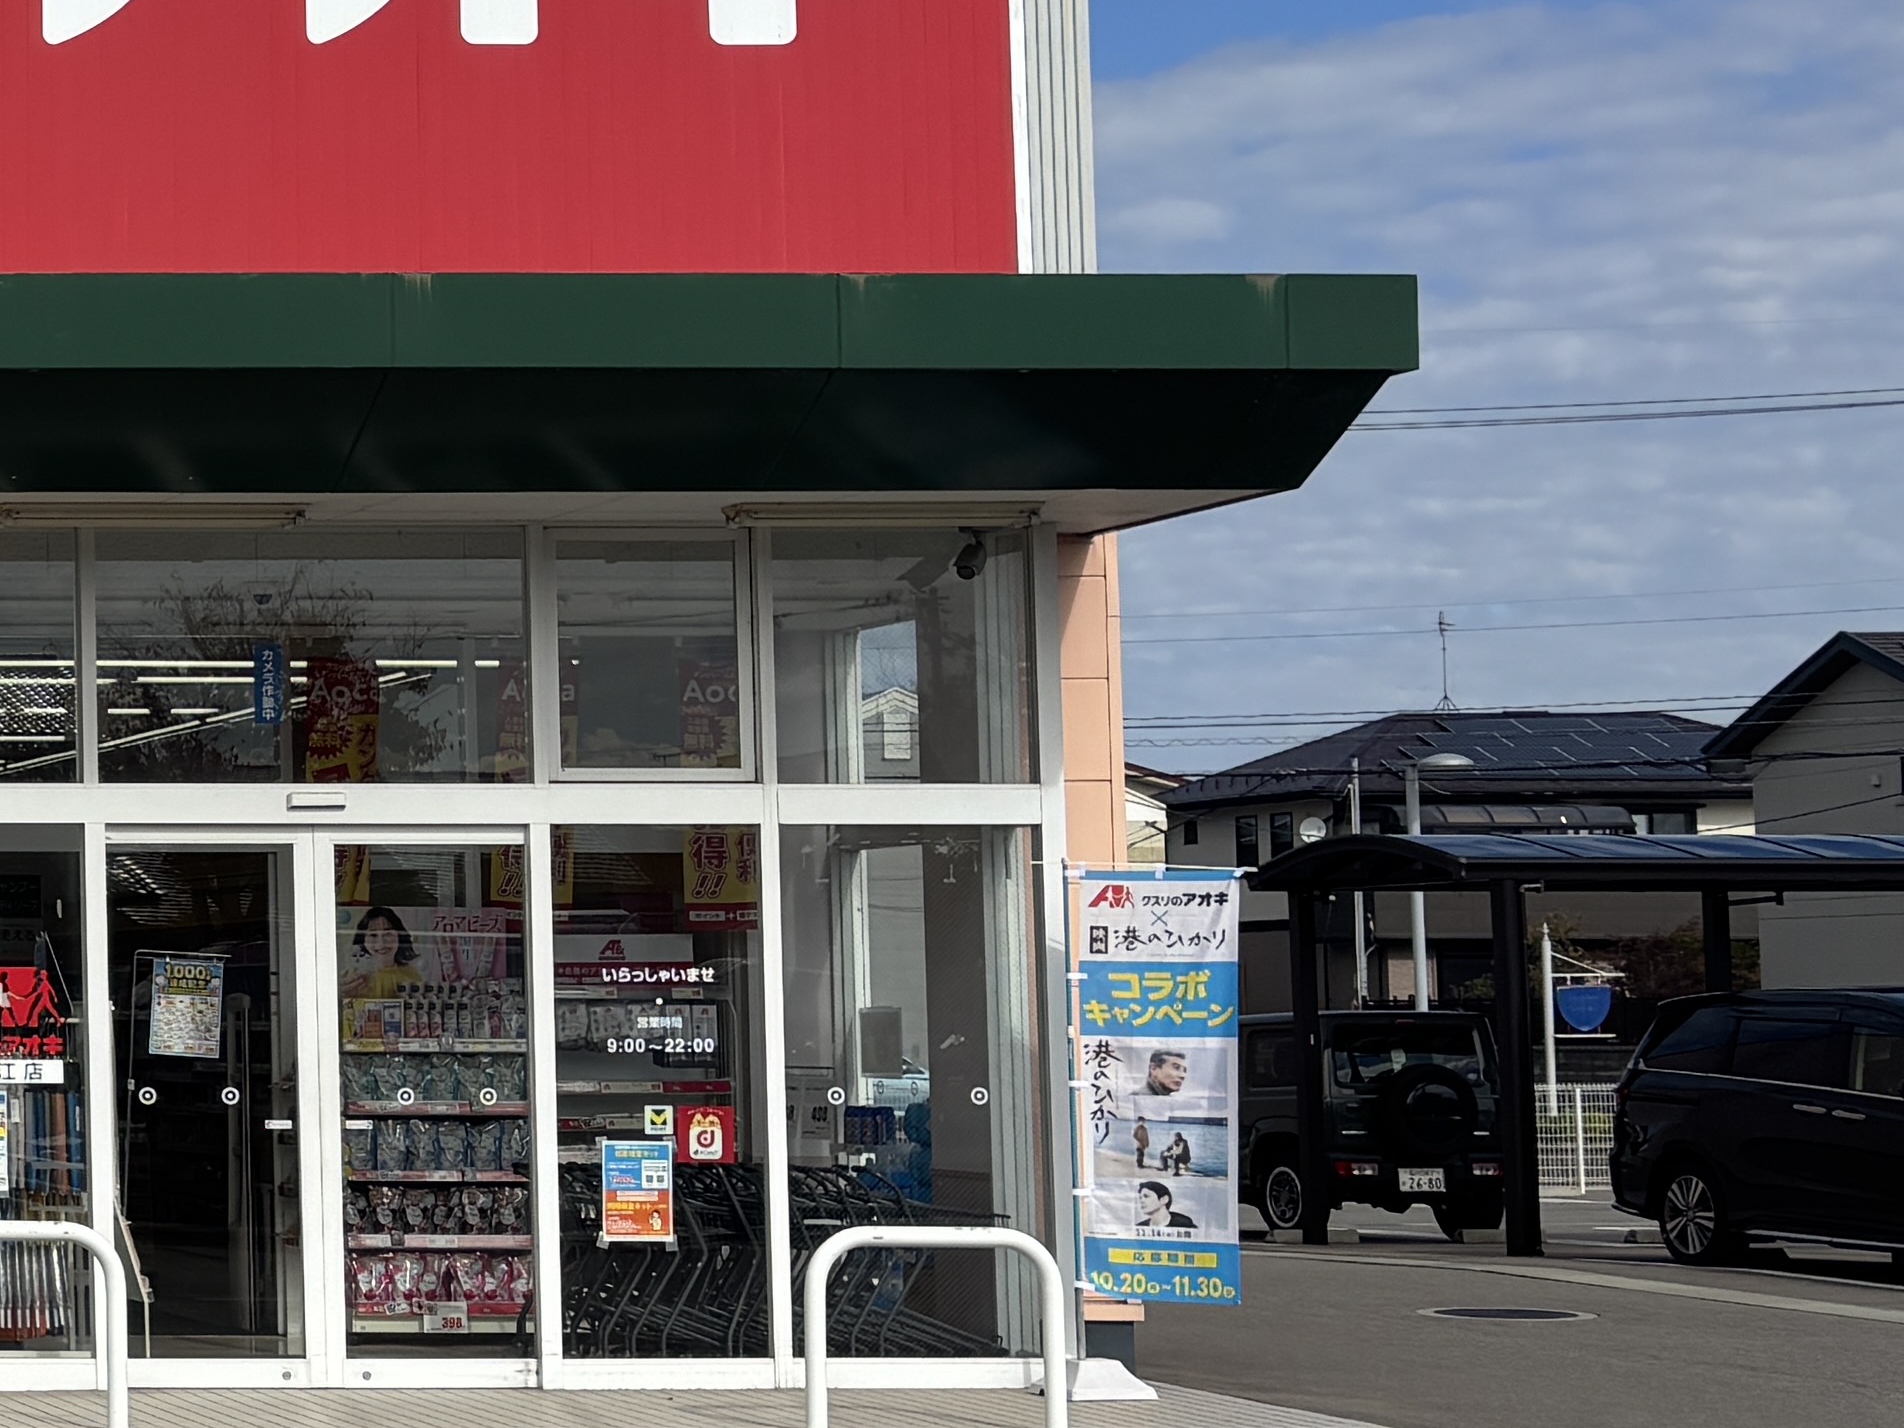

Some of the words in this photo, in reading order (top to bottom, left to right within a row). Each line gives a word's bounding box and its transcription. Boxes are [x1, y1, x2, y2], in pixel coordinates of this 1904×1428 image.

[1142, 892, 1229, 907] クスリのアオキ
[433, 914, 504, 933] アロマビーズ
[1114, 926, 1226, 951] 港のひかり
[601, 967, 716, 983] いらっしゃいませ
[1108, 970, 1211, 1001] コラボ
[1083, 1000, 1235, 1027] キャンペーン
[606, 1038, 715, 1053] 9:00～22:00
[1083, 1039, 1123, 1144] 港のひかり
